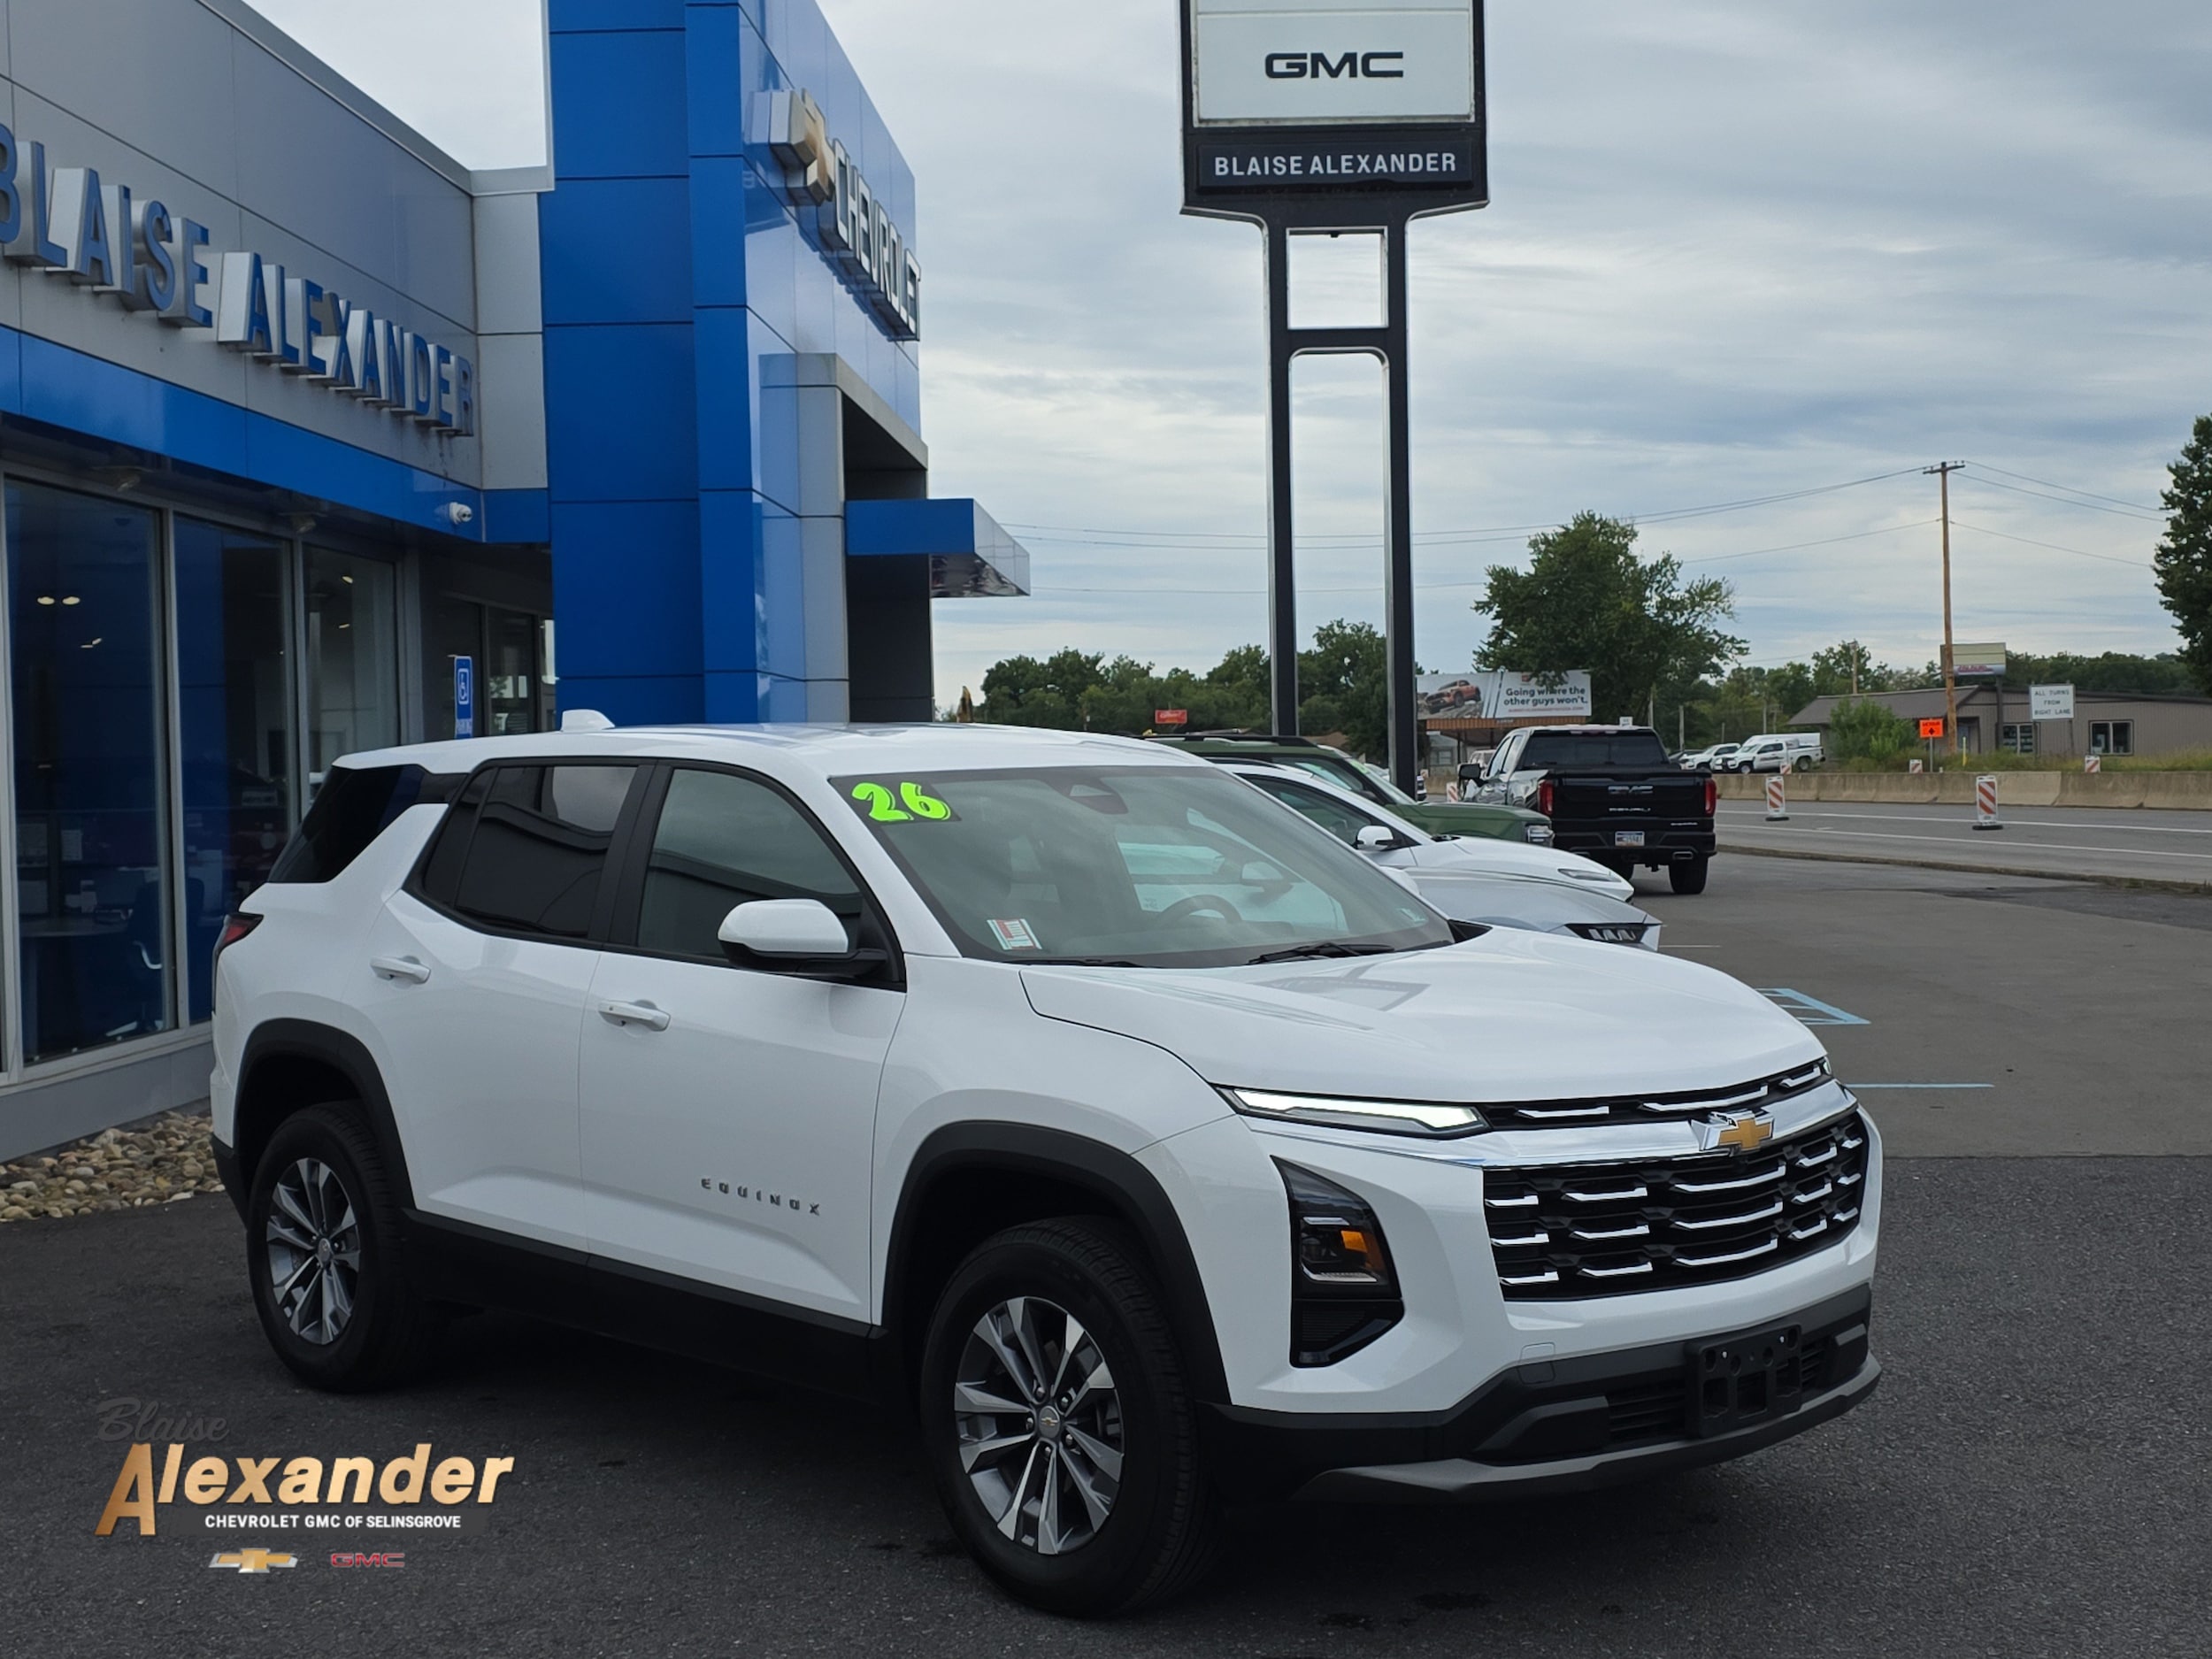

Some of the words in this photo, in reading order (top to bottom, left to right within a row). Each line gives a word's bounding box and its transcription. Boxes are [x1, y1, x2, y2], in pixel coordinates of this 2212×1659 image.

[1265, 51, 1403, 79] GMC
[1215, 156, 1302, 176] BLAISE
[1310, 152, 1456, 175] ALEXANDER
[833, 138, 921, 342] CHEVROLET
[0, 122, 212, 328] BLAISE
[241, 252, 474, 437] ALEXANDER
[1506, 687, 1535, 697] Going
[1557, 695, 1588, 704] won't.
[852, 782, 951, 821] 26
[701, 1178, 819, 1216] EQUINOX
